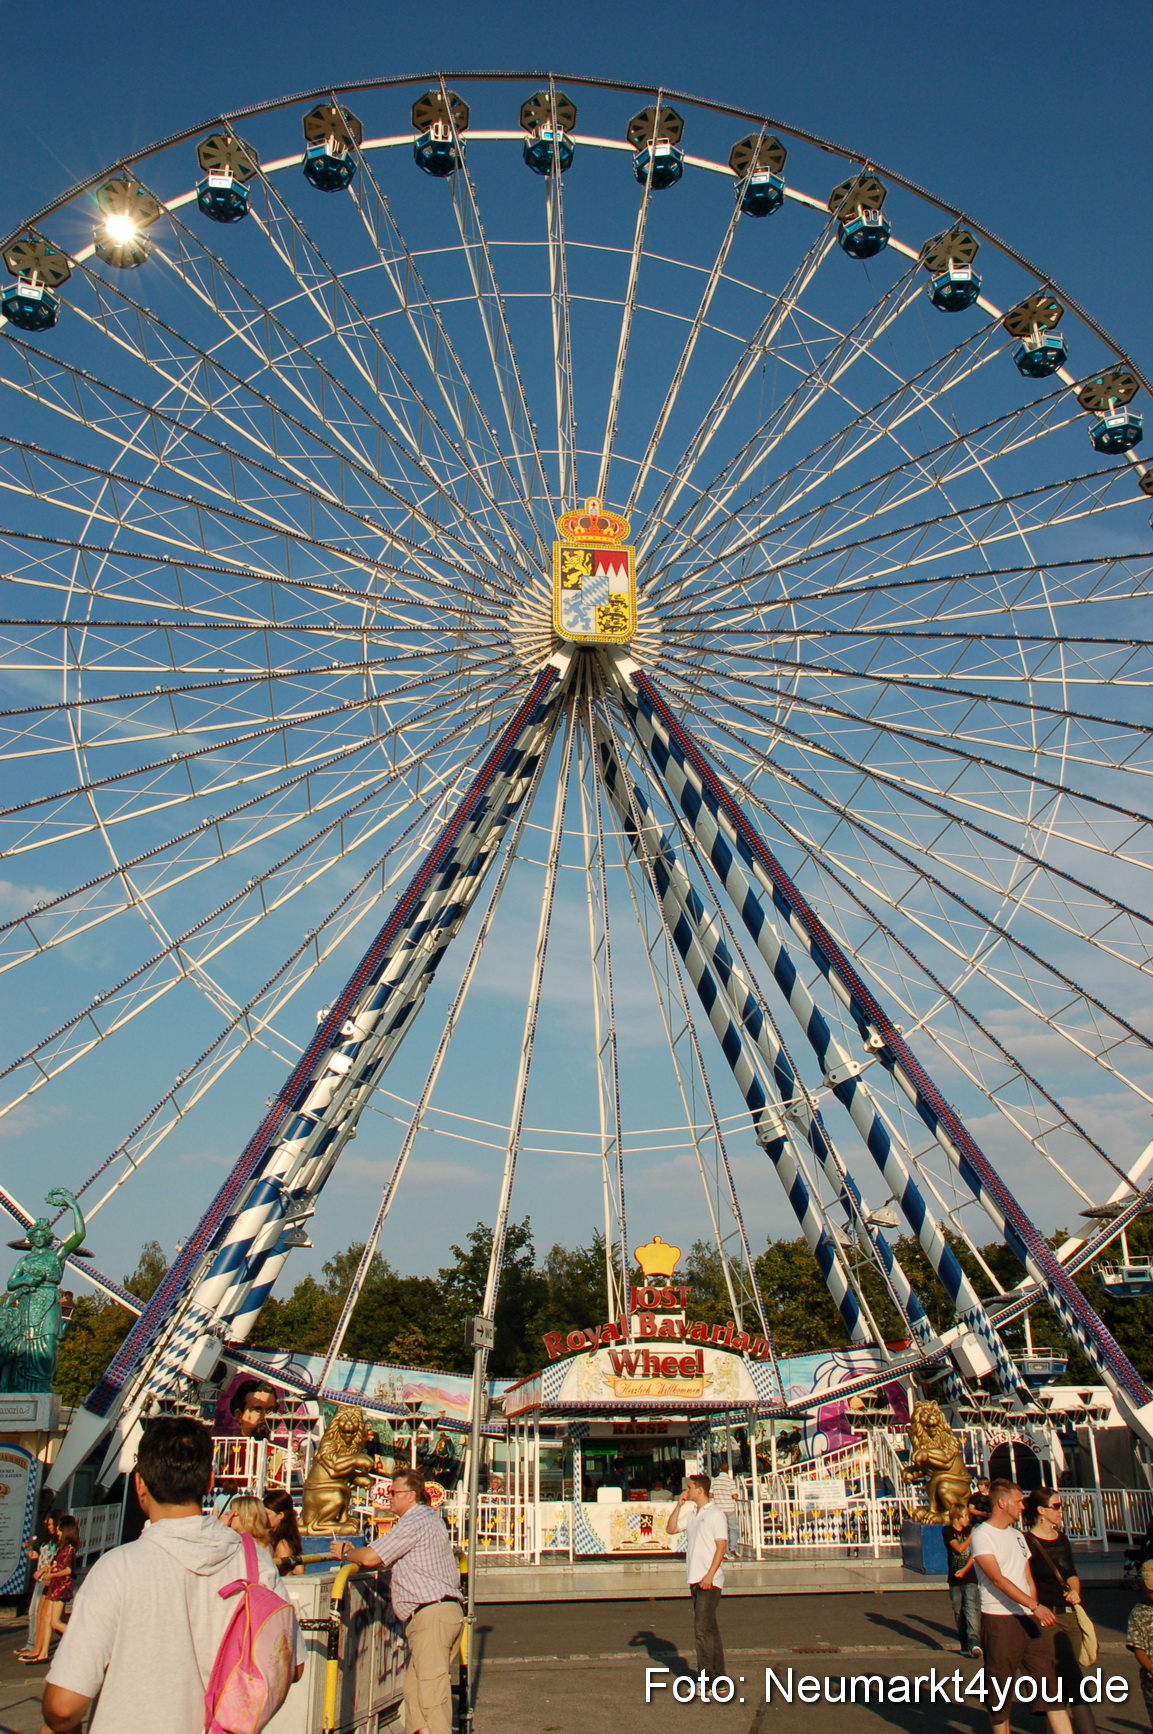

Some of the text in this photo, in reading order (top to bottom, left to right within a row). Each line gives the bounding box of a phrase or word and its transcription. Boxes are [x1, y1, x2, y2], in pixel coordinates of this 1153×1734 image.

[629, 1286, 692, 1314] JOST
[542, 1312, 772, 1360] Royal Bavarian
[608, 1348, 705, 1378] Wheel
[617, 1381, 701, 1395] Herzlich Willkommen
[612, 1423, 668, 1434] KASSE
